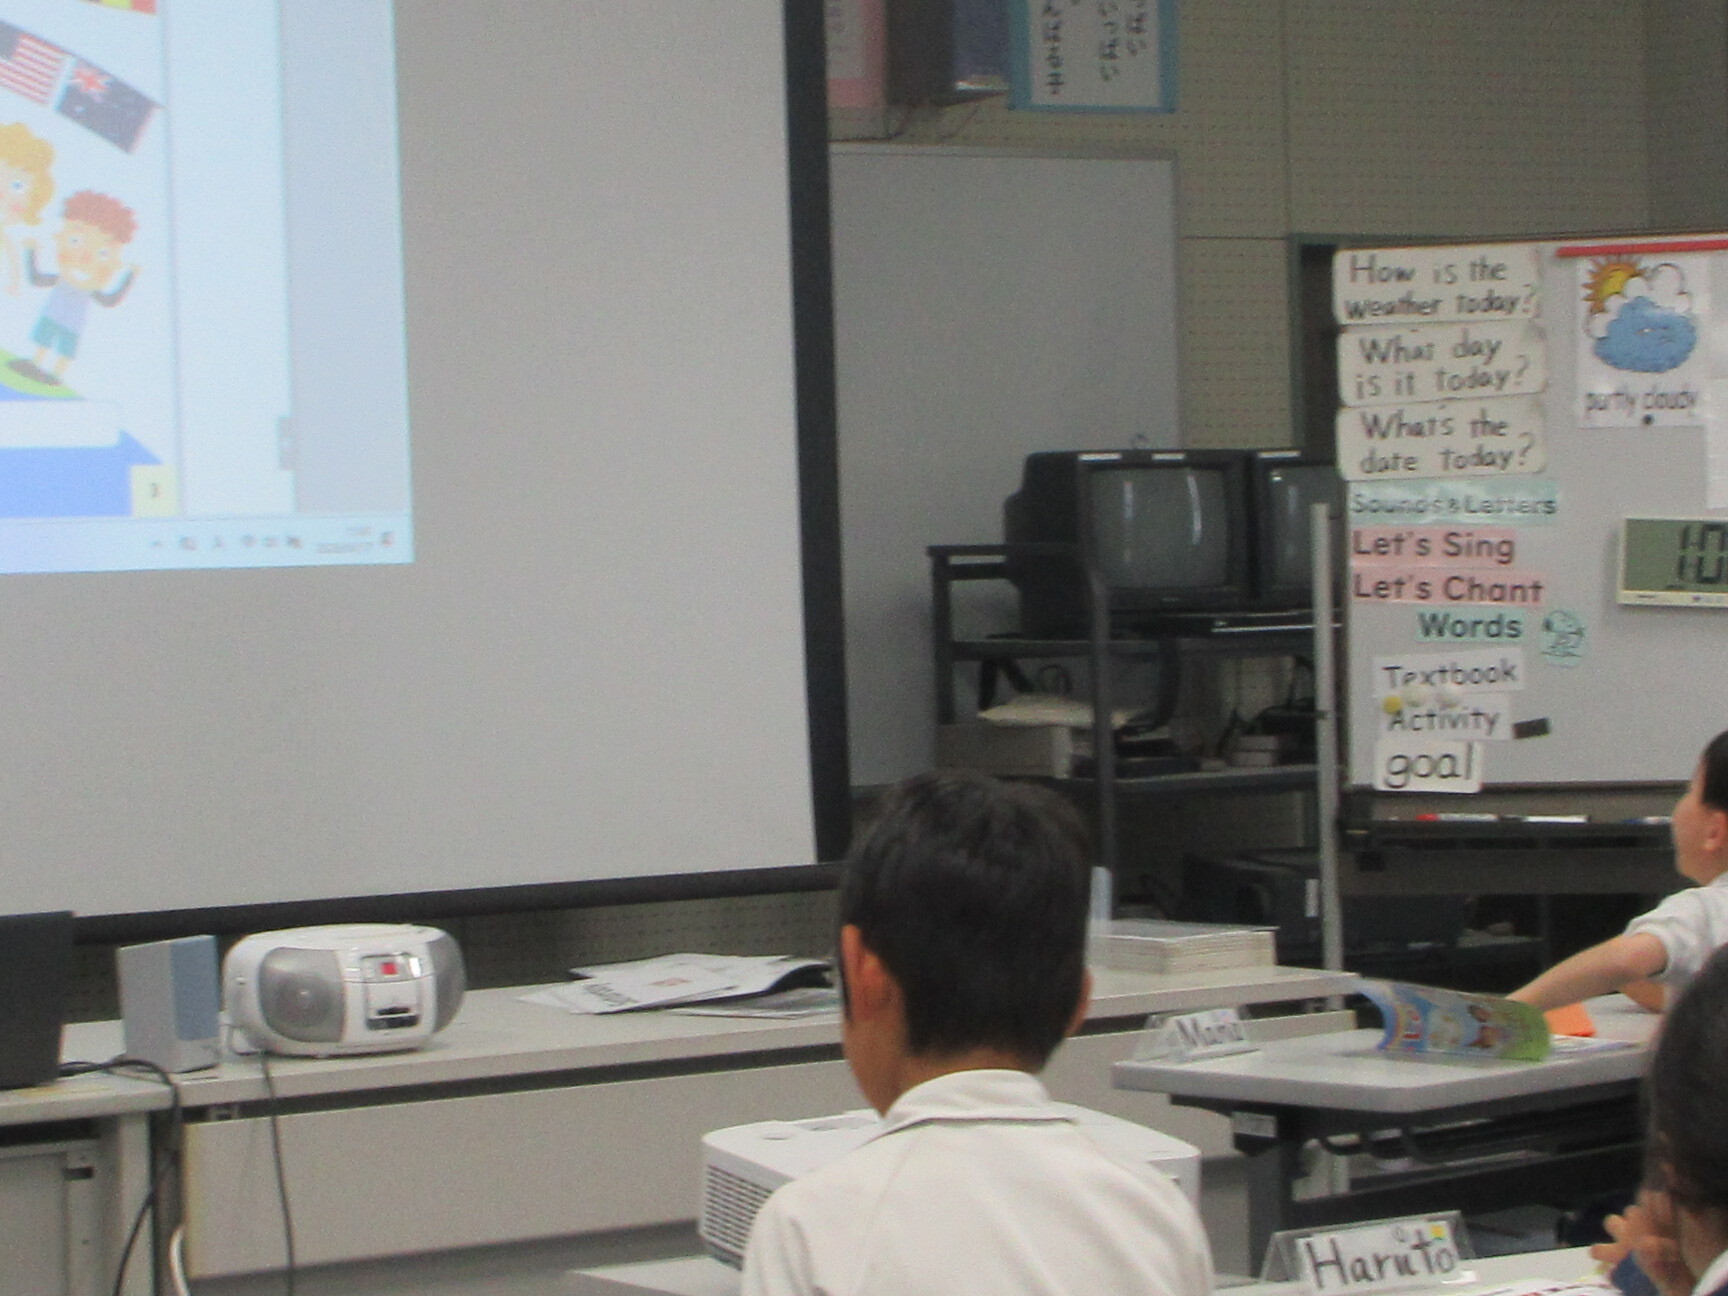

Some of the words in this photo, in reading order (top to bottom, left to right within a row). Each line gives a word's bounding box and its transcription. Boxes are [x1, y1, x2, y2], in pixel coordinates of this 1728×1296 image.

[1349, 254, 1416, 284] How
[1432, 262, 1458, 284] is
[1468, 256, 1508, 282] the
[1358, 334, 1437, 364] What
[1452, 327, 1503, 366] day
[1355, 374, 1382, 399] is
[1396, 371, 1415, 397] it
[1469, 408, 1510, 437] the
[1360, 447, 1420, 474] date
[1352, 530, 1432, 556] Let's
[1442, 531, 1516, 565] Sing
[1353, 574, 1433, 600] Let's
[1442, 575, 1546, 603] Chant
[1417, 610, 1523, 639] Words
[1381, 657, 1519, 689] Textbook
[1386, 707, 1502, 738] Activity
[1384, 741, 1474, 789] goal
[1305, 1229, 1456, 1290] Haruto
